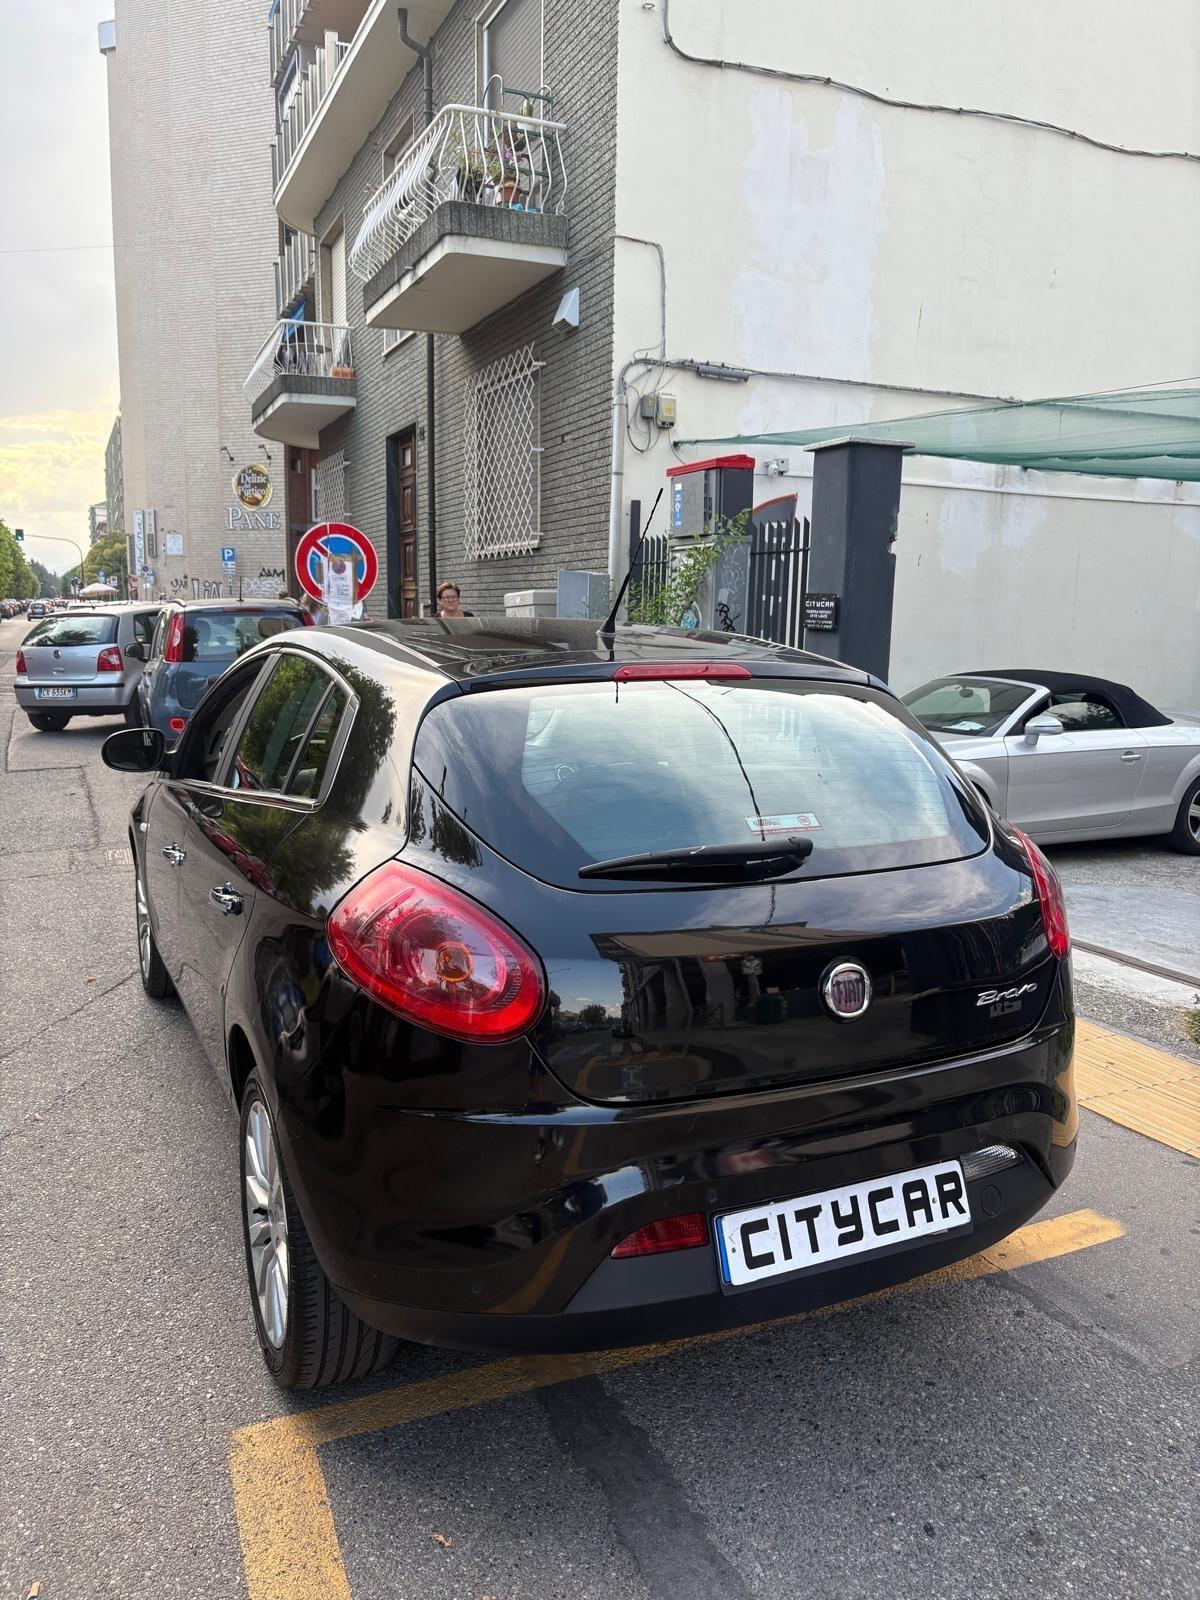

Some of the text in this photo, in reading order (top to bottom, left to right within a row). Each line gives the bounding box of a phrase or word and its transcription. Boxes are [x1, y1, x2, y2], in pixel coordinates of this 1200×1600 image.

[240, 473, 267, 483] Delizie
[239, 485, 266, 496] Portico
[224, 506, 281, 530] PANE
[224, 548, 233, 559] P
[805, 600, 835, 608] CITYCAR
[832, 975, 865, 1004] FIAT
[976, 982, 1038, 1007] Bravo
[740, 1170, 968, 1270] CITYCAR
